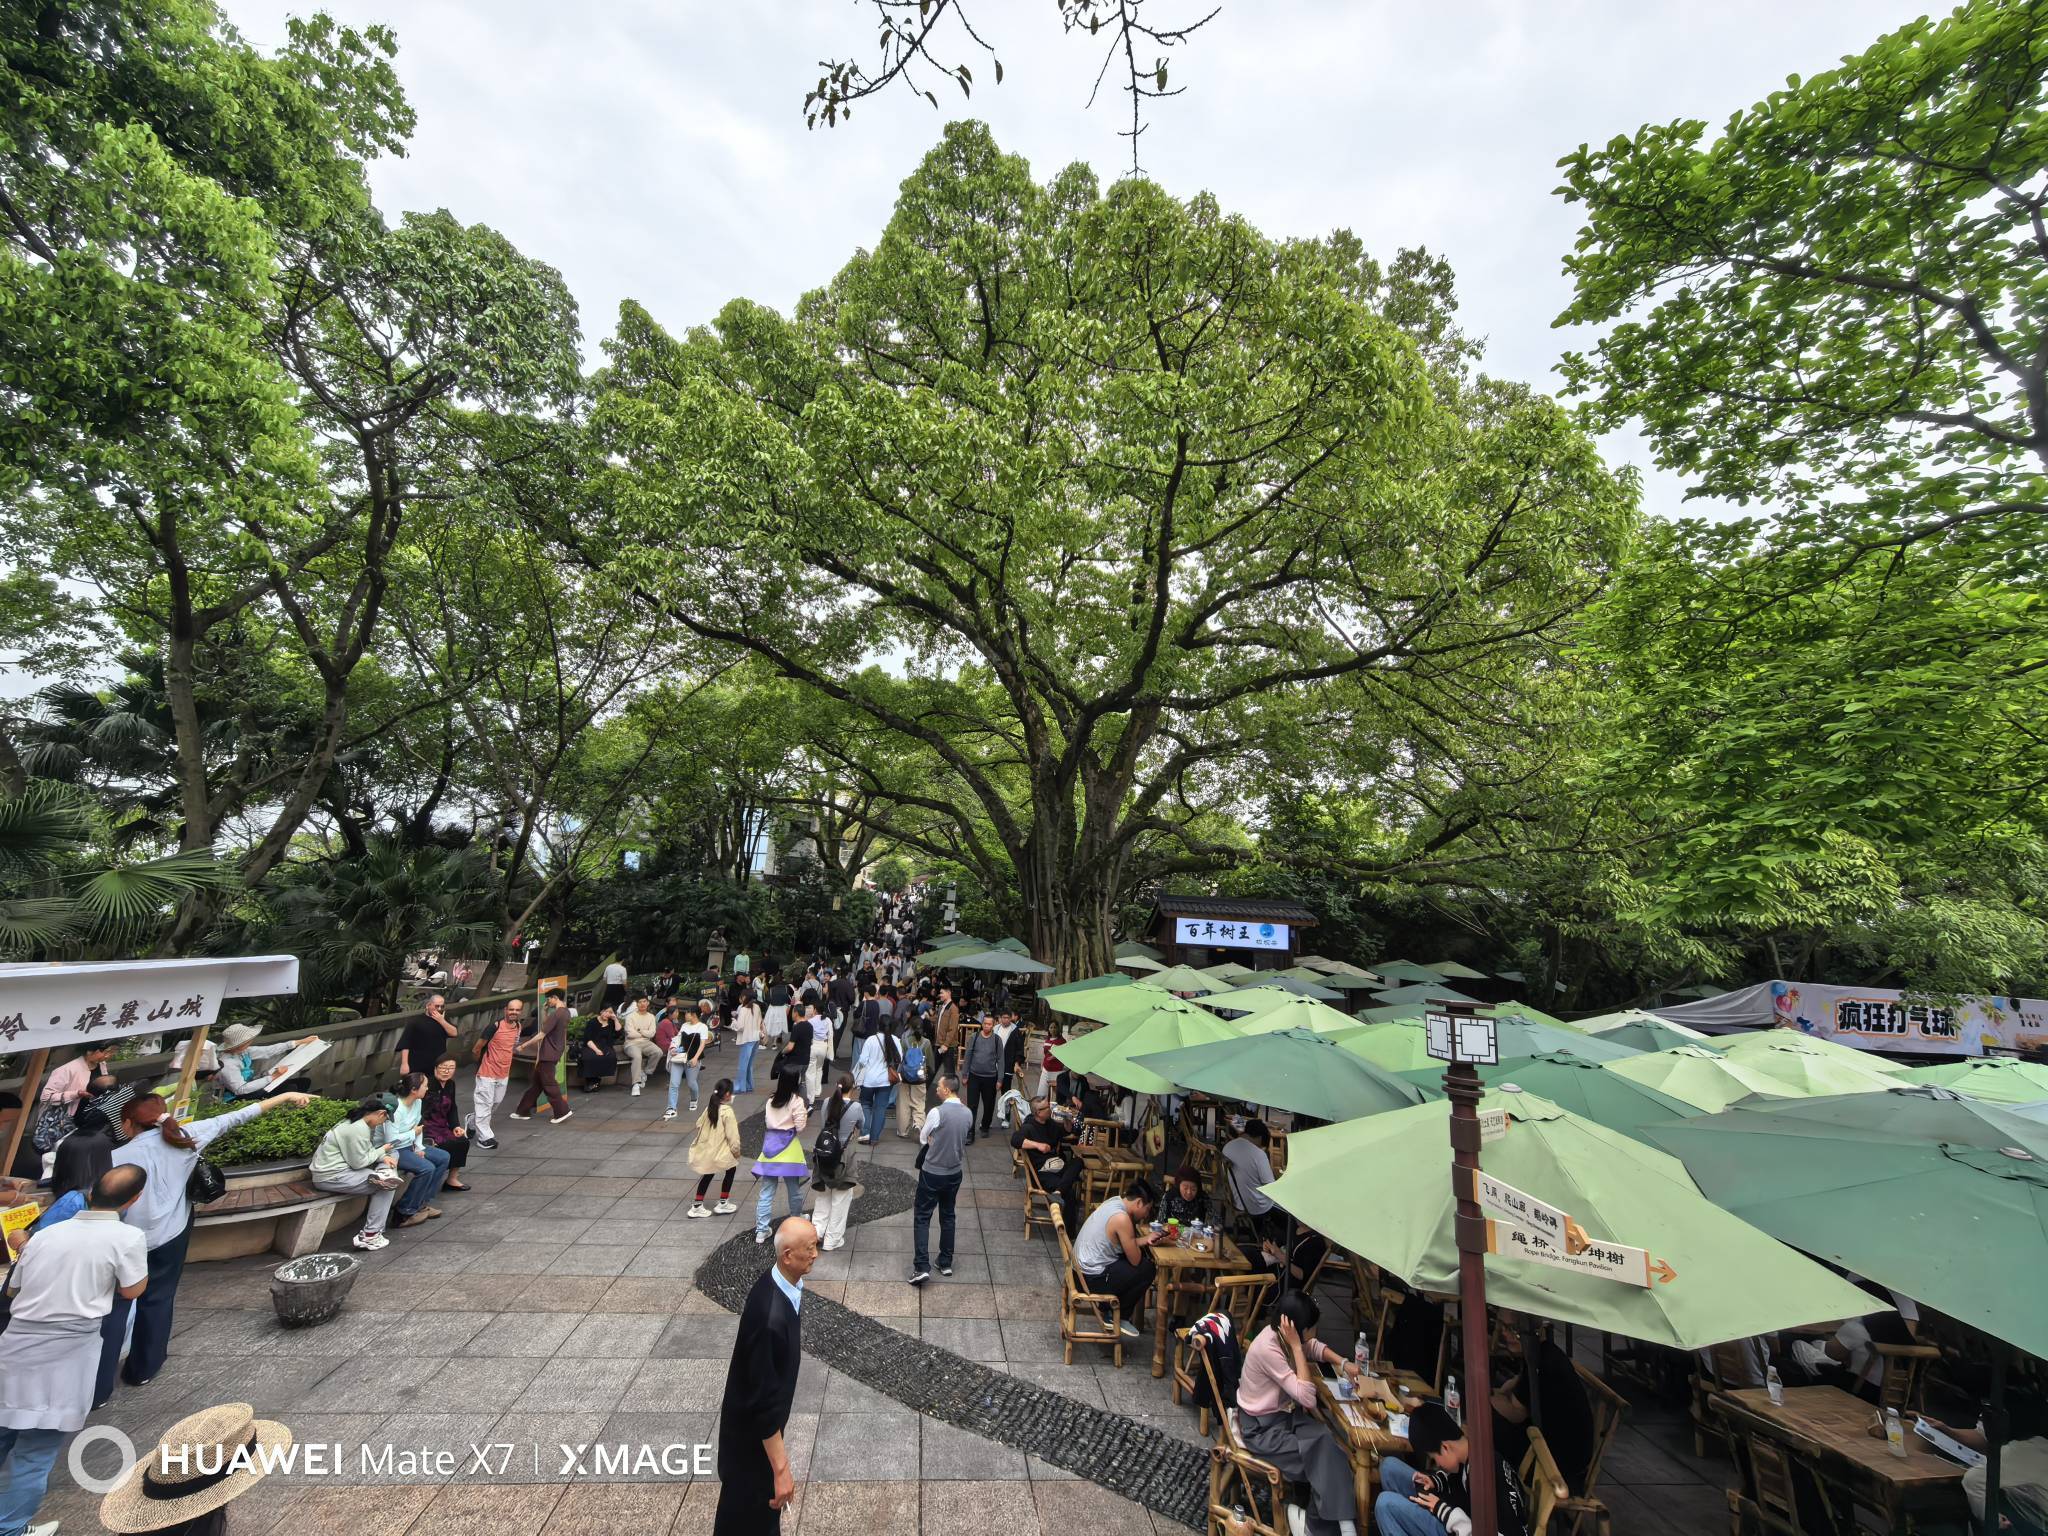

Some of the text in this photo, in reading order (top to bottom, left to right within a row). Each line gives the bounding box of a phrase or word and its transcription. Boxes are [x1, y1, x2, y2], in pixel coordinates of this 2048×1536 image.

[1185, 922, 1250, 940] 百年树王
[1839, 1002, 1956, 1036] 疯狂打气球
[1511, 1231, 1624, 1265] 绳桥、坤榭
[1524, 1247, 1540, 1256] Rope
